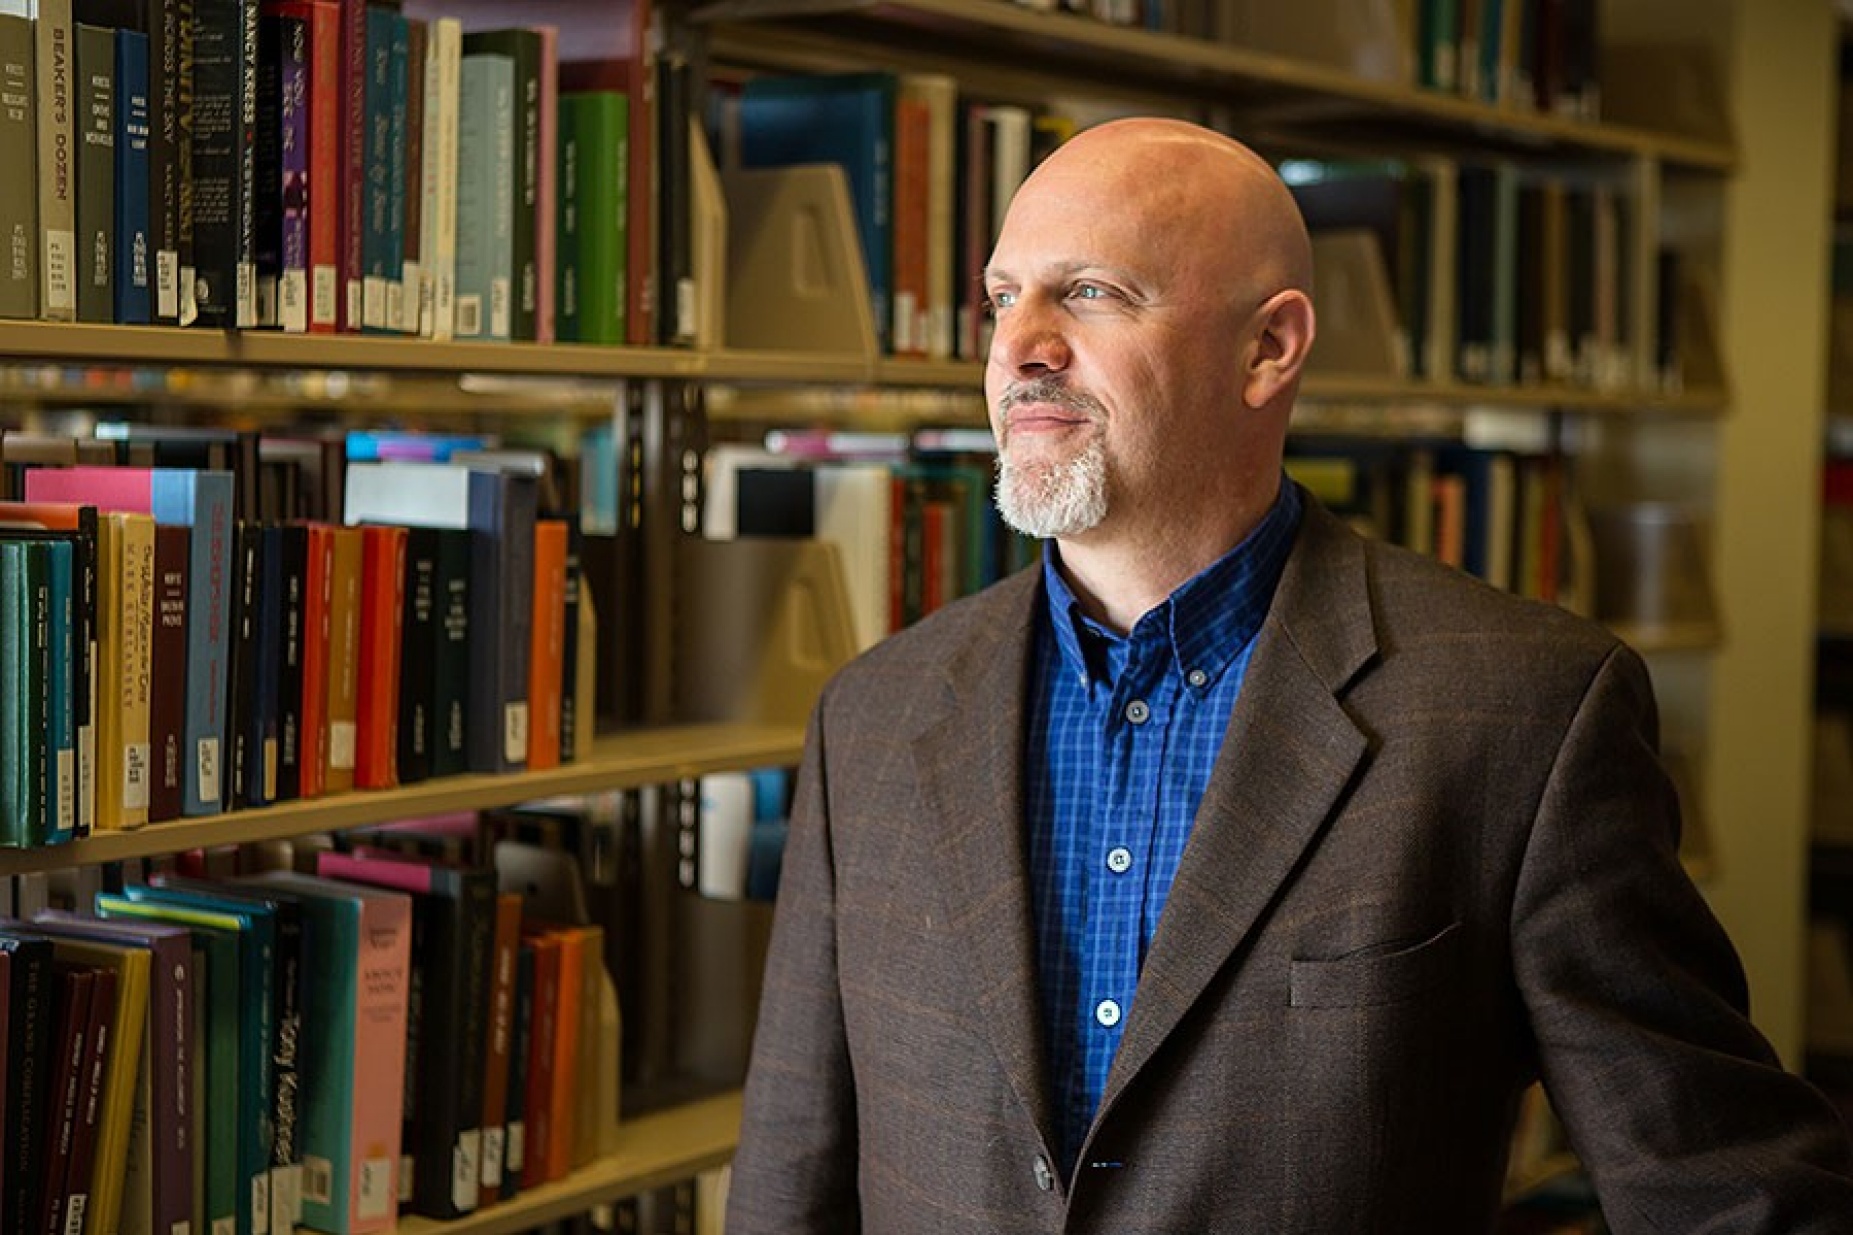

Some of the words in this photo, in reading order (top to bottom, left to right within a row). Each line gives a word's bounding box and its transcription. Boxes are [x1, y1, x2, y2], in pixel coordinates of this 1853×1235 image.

[163, 12, 174, 73] ACROSS
[245, 3, 256, 63] NANCY
[53, 28, 66, 124] BEAKER'S
[163, 79, 174, 107] THE
[243, 68, 255, 124] KRESS
[163, 112, 173, 143] SKY
[54, 134, 67, 201] DOZEN
[274, 1013, 301, 1068] Tony
